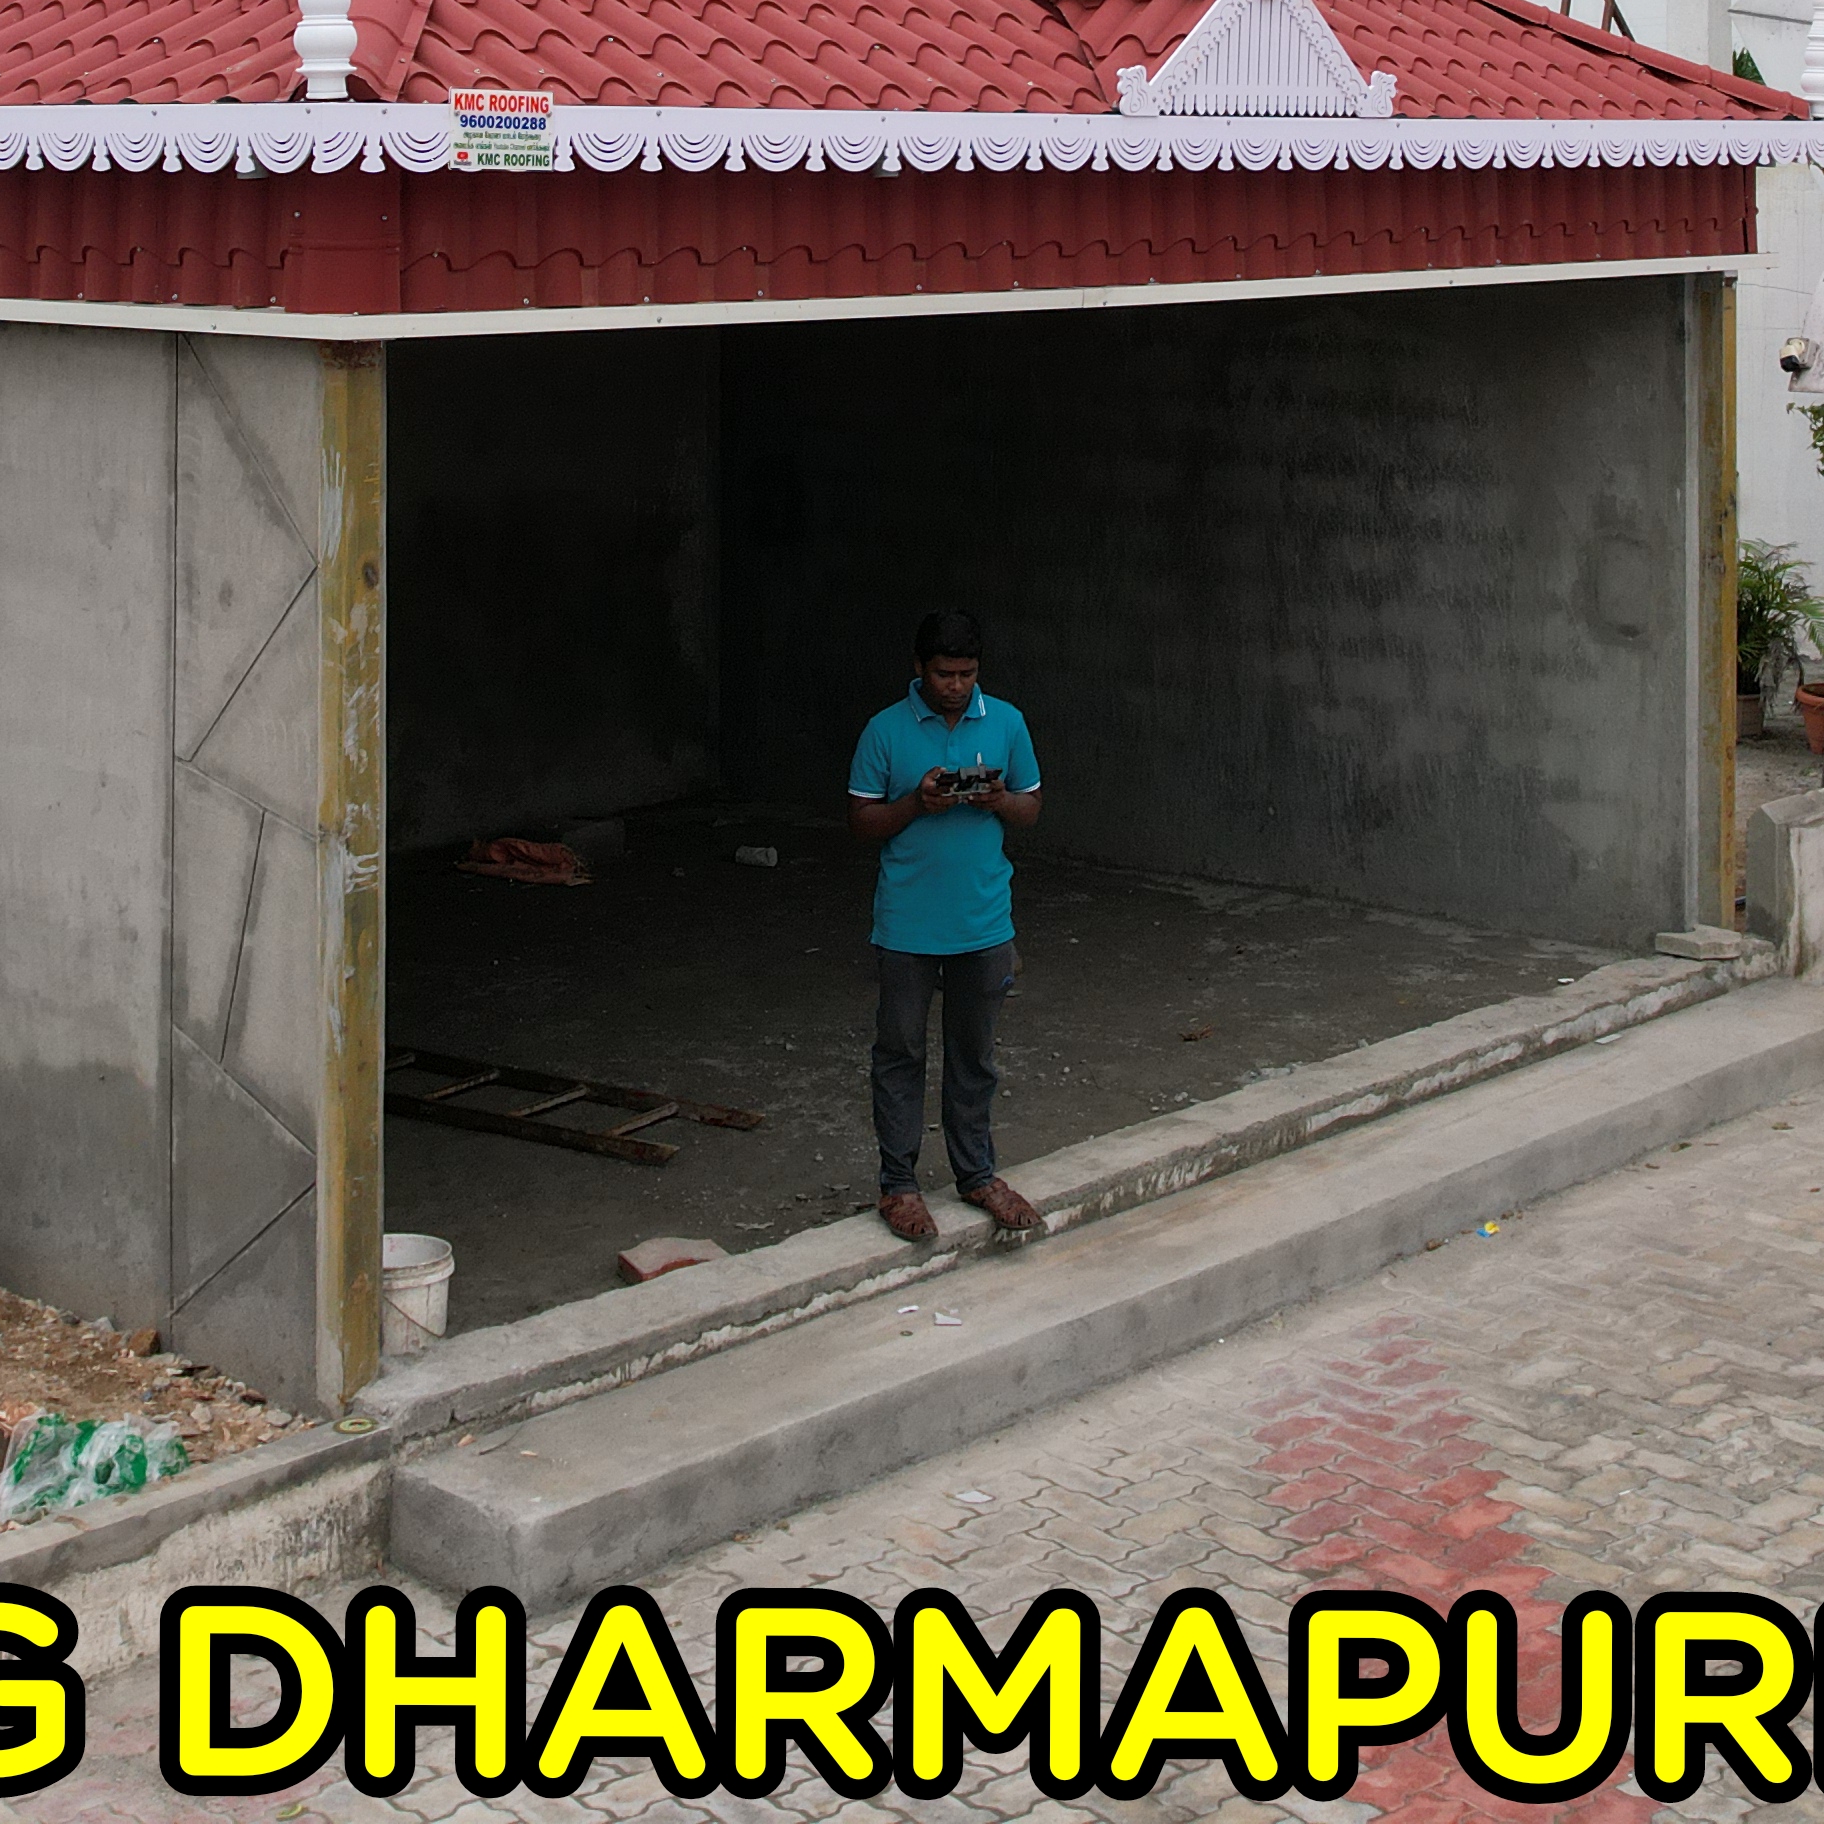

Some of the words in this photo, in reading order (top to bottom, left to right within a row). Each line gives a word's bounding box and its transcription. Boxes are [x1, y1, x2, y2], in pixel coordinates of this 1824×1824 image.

[454, 93, 485, 111] KMC
[489, 94, 549, 114] ROOFING
[459, 114, 547, 130] 9600200288
[477, 153, 501, 166] KMC
[504, 154, 550, 167] ROOFING
